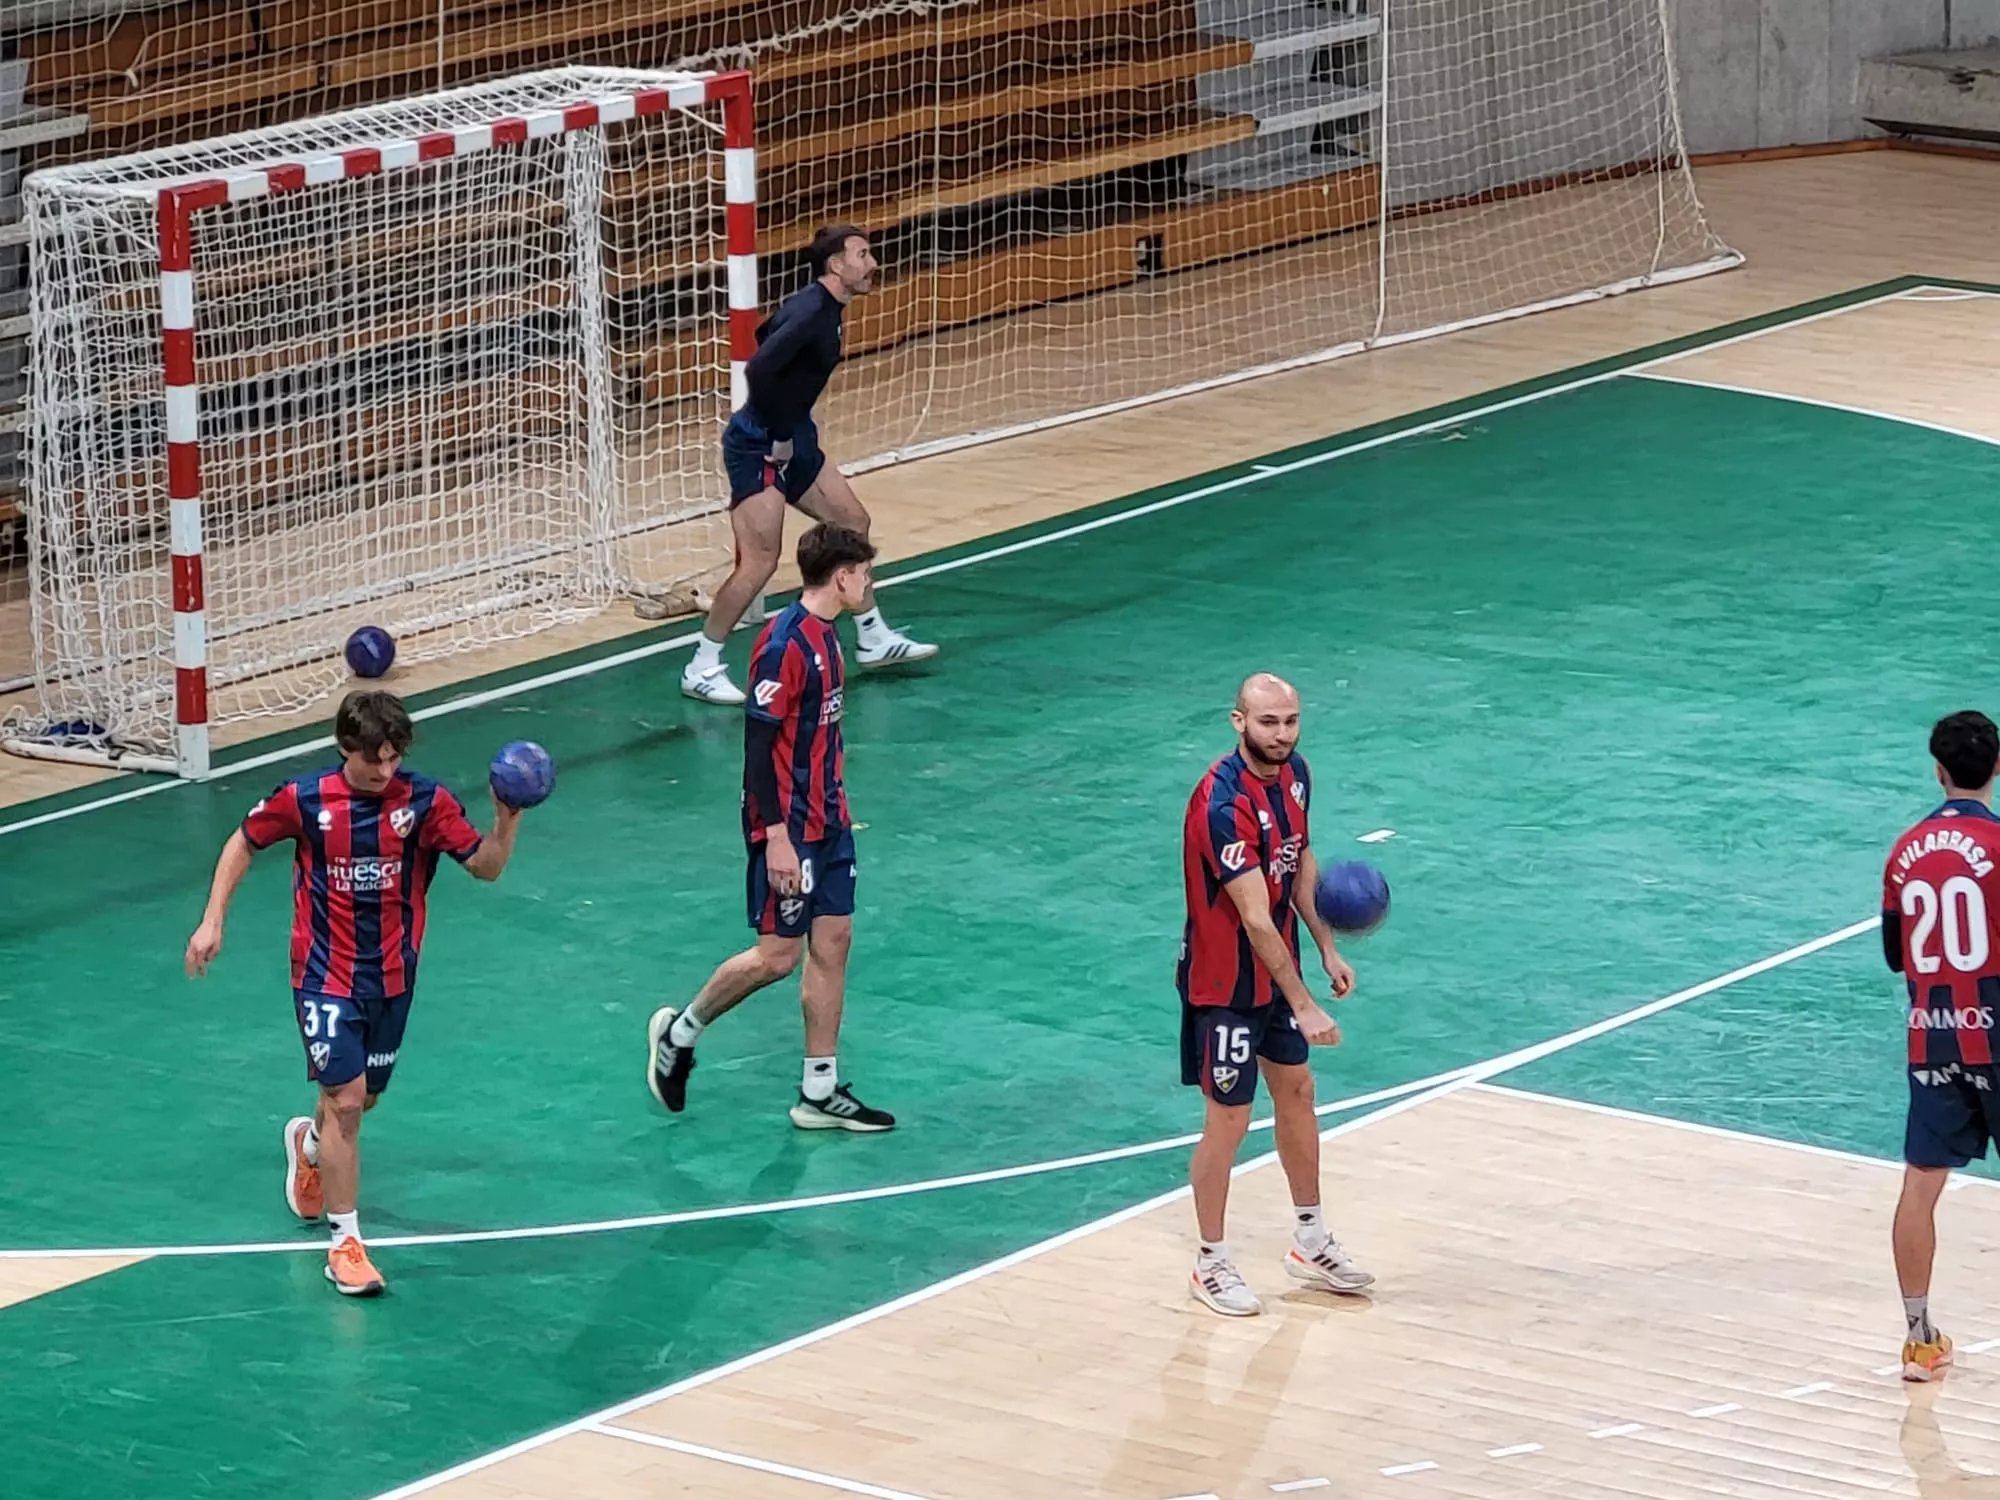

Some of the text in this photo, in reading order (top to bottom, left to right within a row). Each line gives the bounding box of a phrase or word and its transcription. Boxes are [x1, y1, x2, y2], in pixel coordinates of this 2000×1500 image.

[327, 861, 402, 881] Huesca
[1901, 875, 1990, 974] 20
[303, 1000, 341, 1038] 37
[1214, 1025, 1251, 1064] 15
